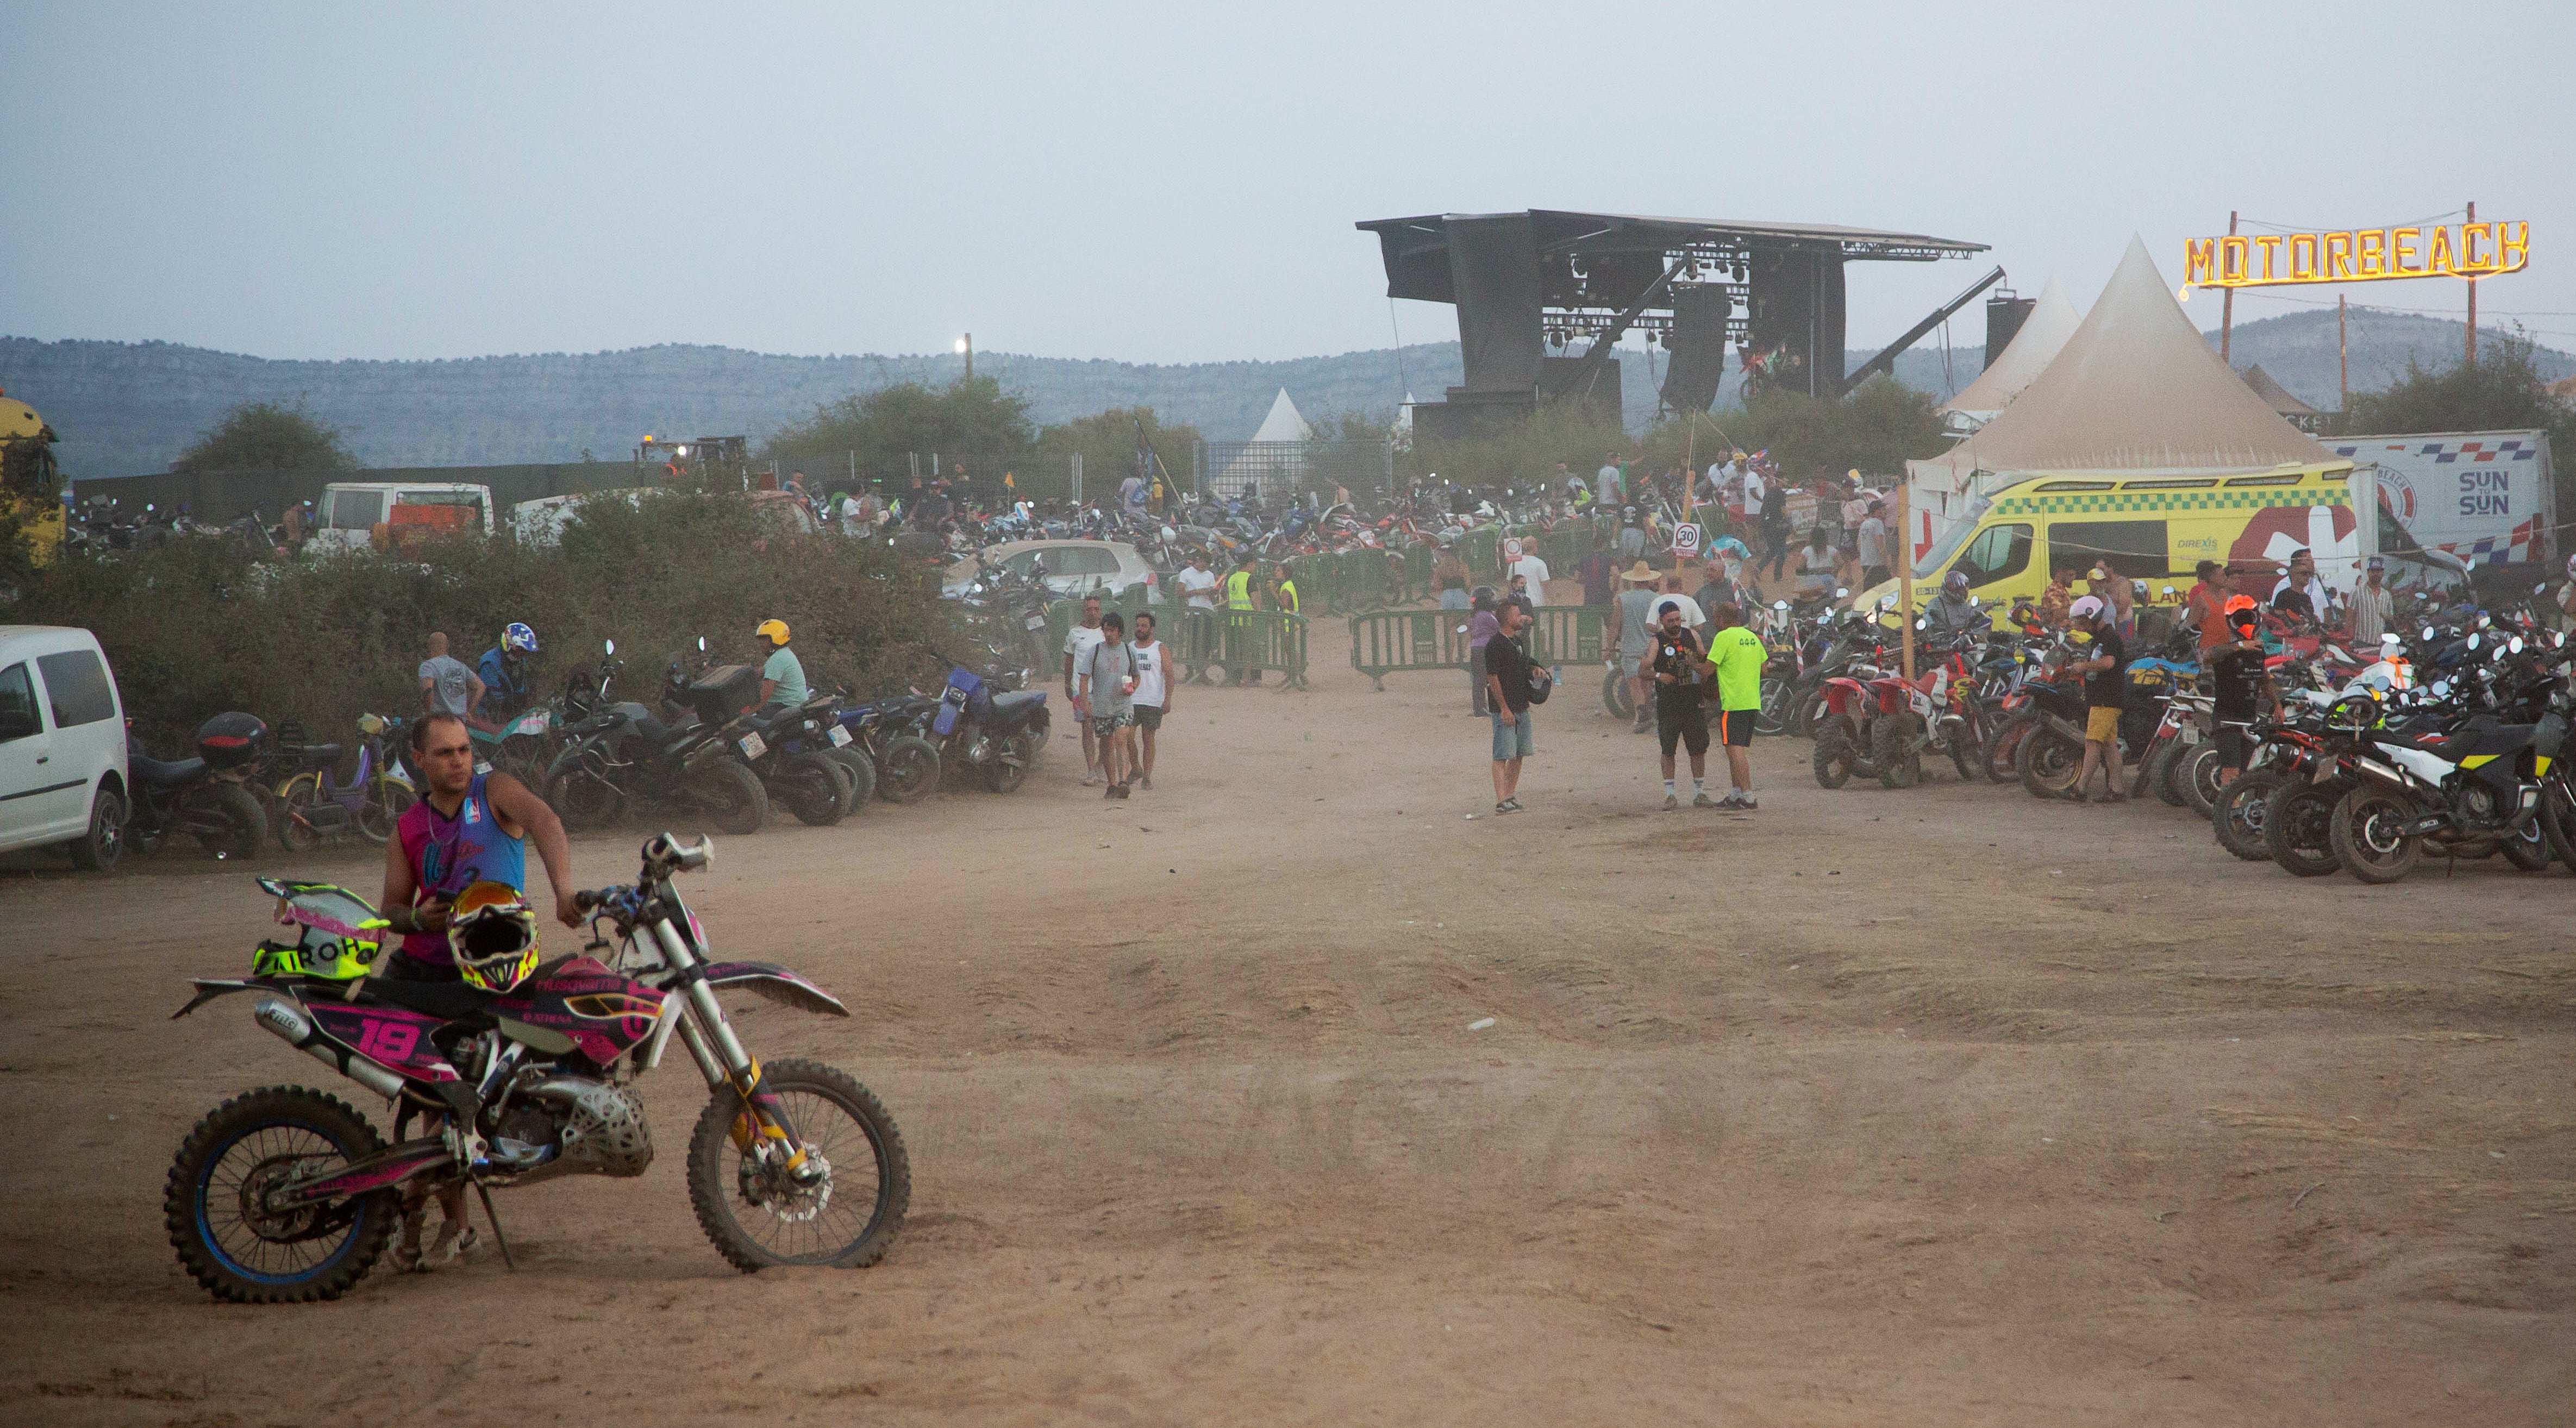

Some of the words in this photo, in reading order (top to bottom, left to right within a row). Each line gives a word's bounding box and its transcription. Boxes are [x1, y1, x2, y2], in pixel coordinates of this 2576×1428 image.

[2185, 221, 2529, 284] MOTORBEACH
[2378, 469, 2407, 488] BEACH
[2460, 471, 2509, 491] SUN
[2460, 495, 2509, 515] SUN
[1680, 530, 1693, 542] 30
[2178, 537, 2217, 548] DIREXIS
[273, 938, 360, 972] AIROH
[358, 1018, 421, 1061] 19
